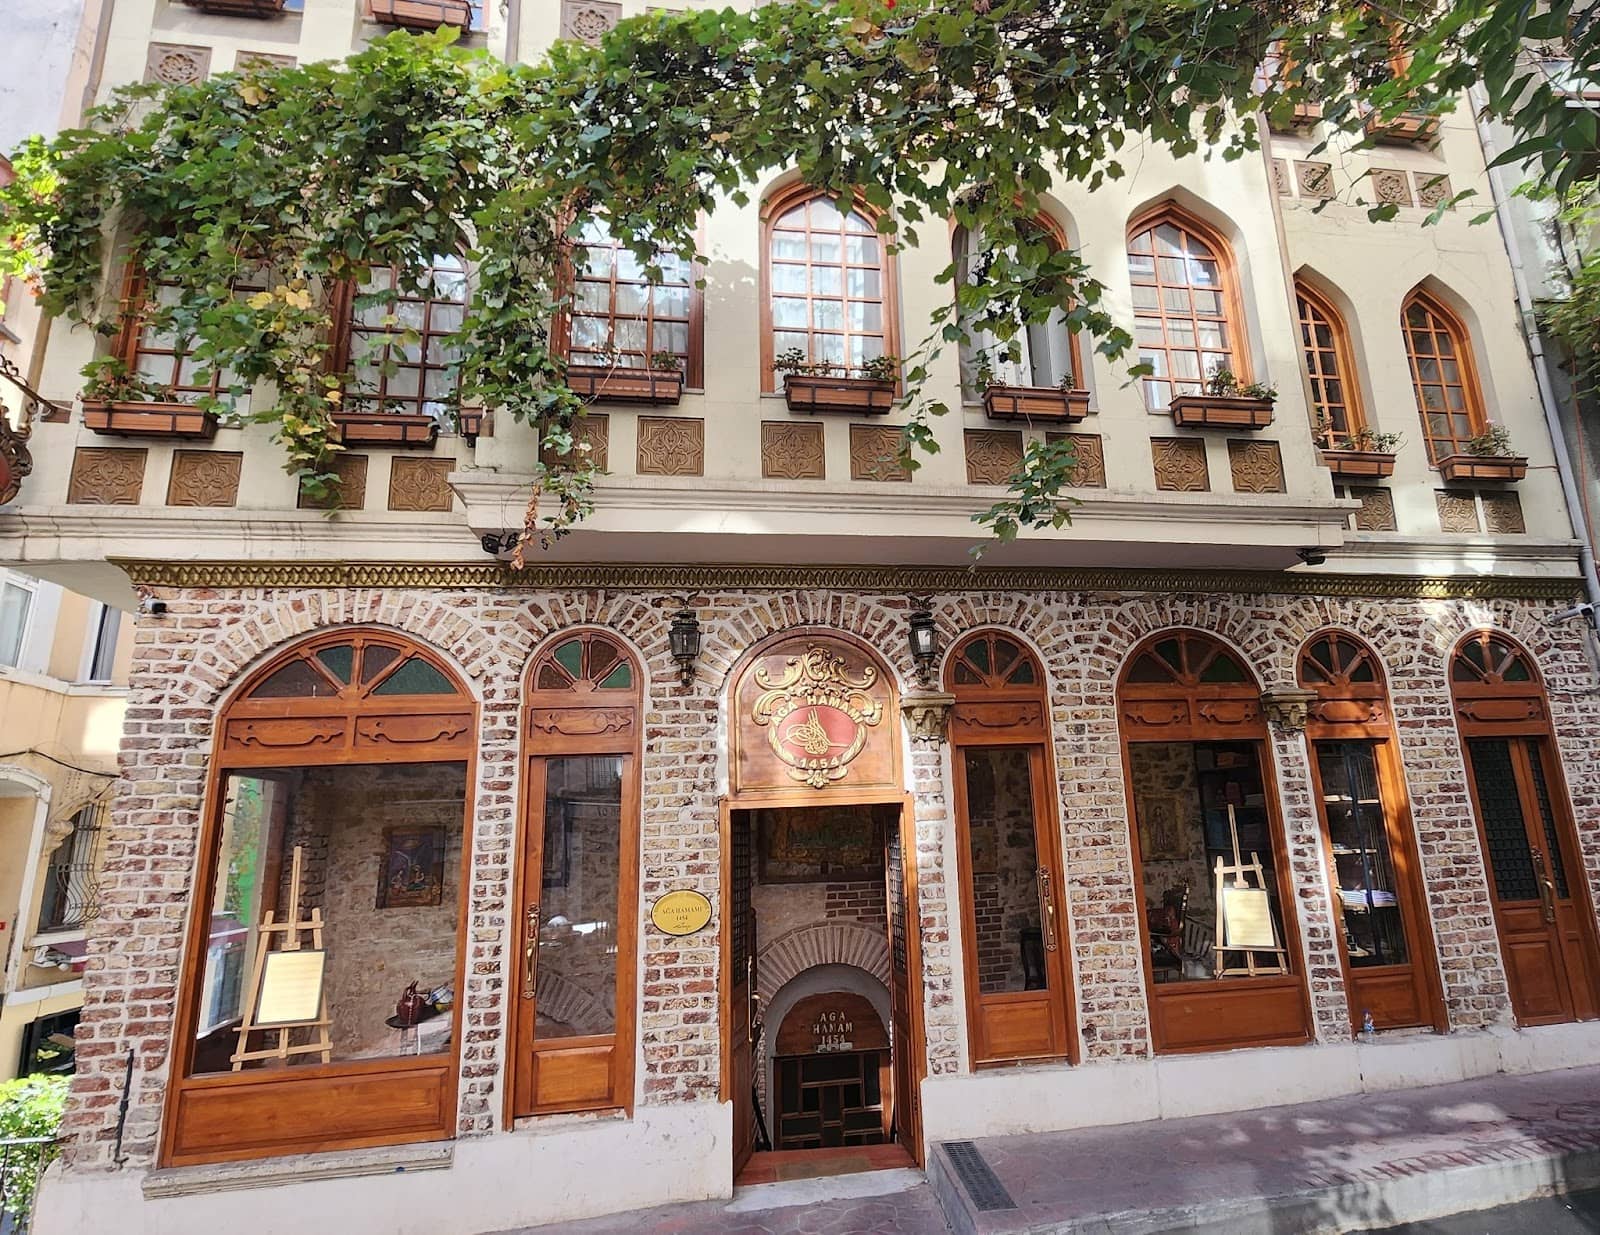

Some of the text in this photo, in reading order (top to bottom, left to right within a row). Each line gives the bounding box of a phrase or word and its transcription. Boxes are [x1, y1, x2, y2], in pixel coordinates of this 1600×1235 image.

[771, 695, 864, 726] AGA HAMAMI
[799, 757, 839, 769] 1454
[820, 1011, 846, 1022] AGA
[813, 1022, 853, 1034] HAMAM
[822, 1034, 846, 1044] 1454
